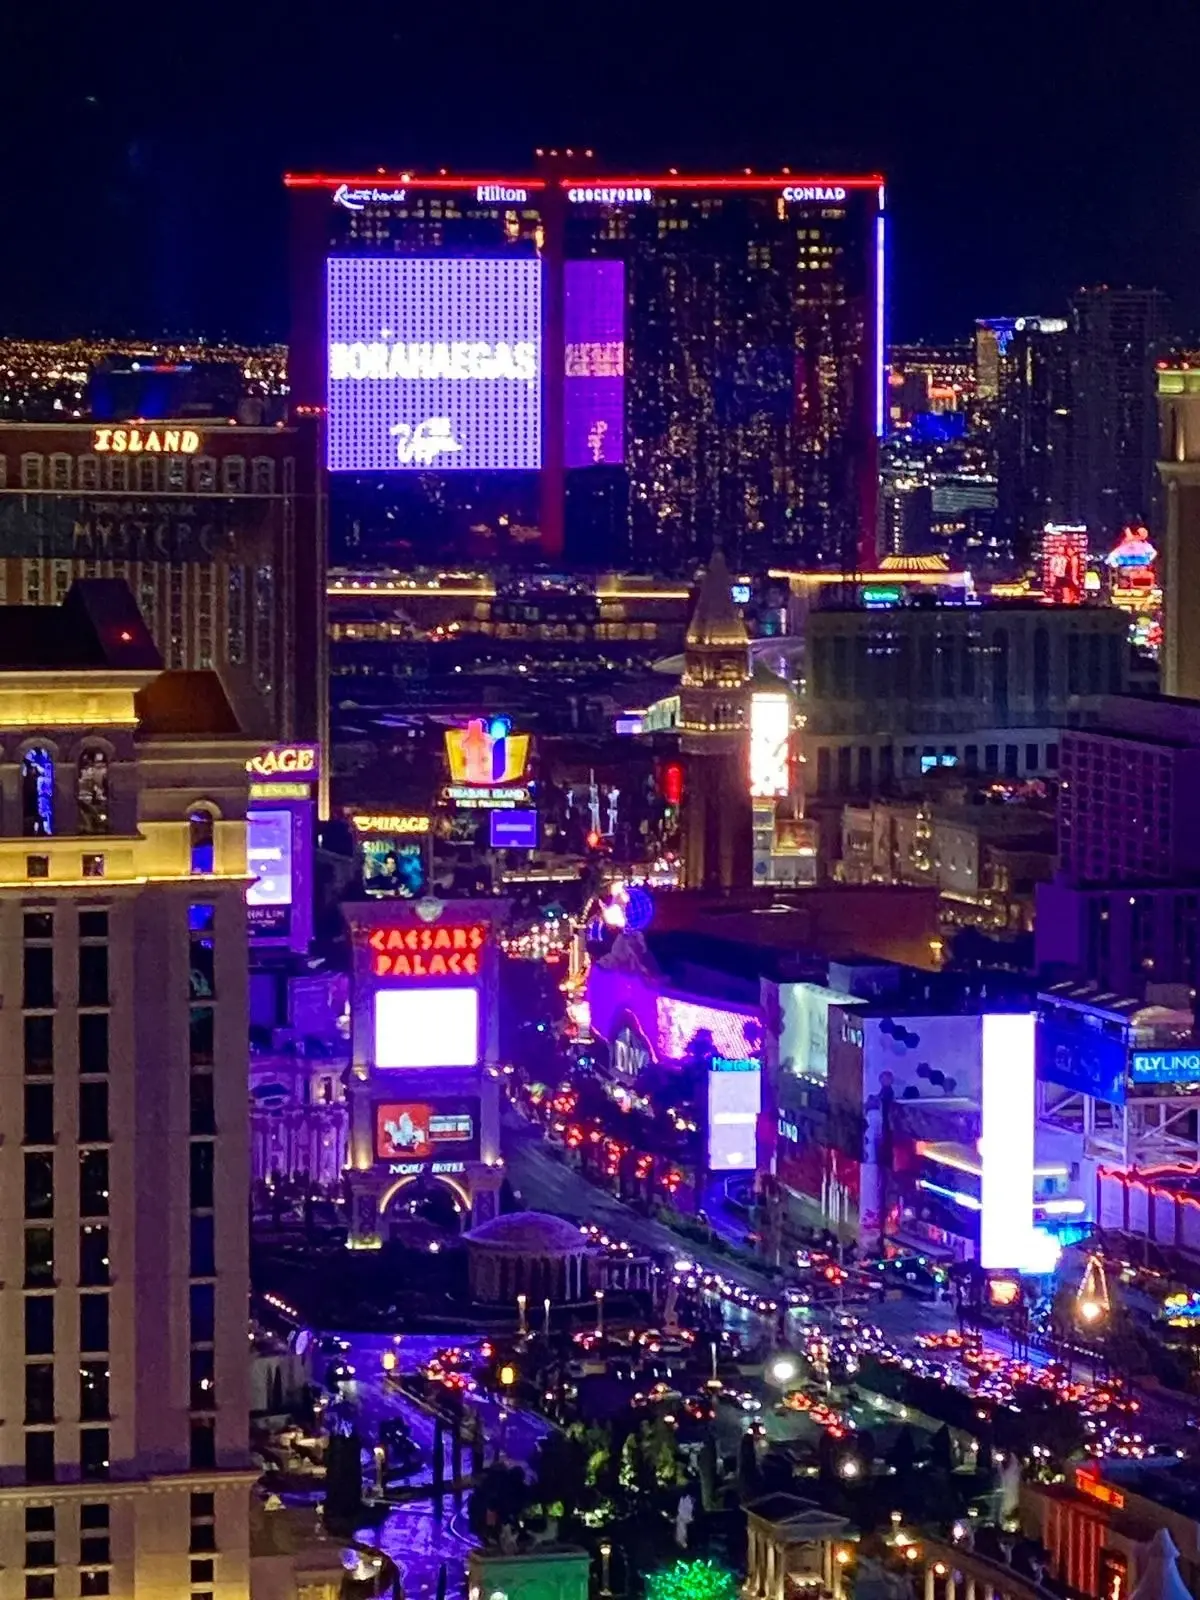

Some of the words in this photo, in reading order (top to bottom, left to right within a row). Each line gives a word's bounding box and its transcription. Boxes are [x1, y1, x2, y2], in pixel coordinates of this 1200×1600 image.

[477, 186, 527, 202] Hilton
[568, 188, 652, 203] CROCKFORDS
[782, 187, 847, 201] CONRAD
[93, 429, 200, 453] ISLAND
[369, 927, 484, 950] CAESARS
[375, 952, 478, 977] PALACE
[431, 1162, 466, 1174] HOTEL
